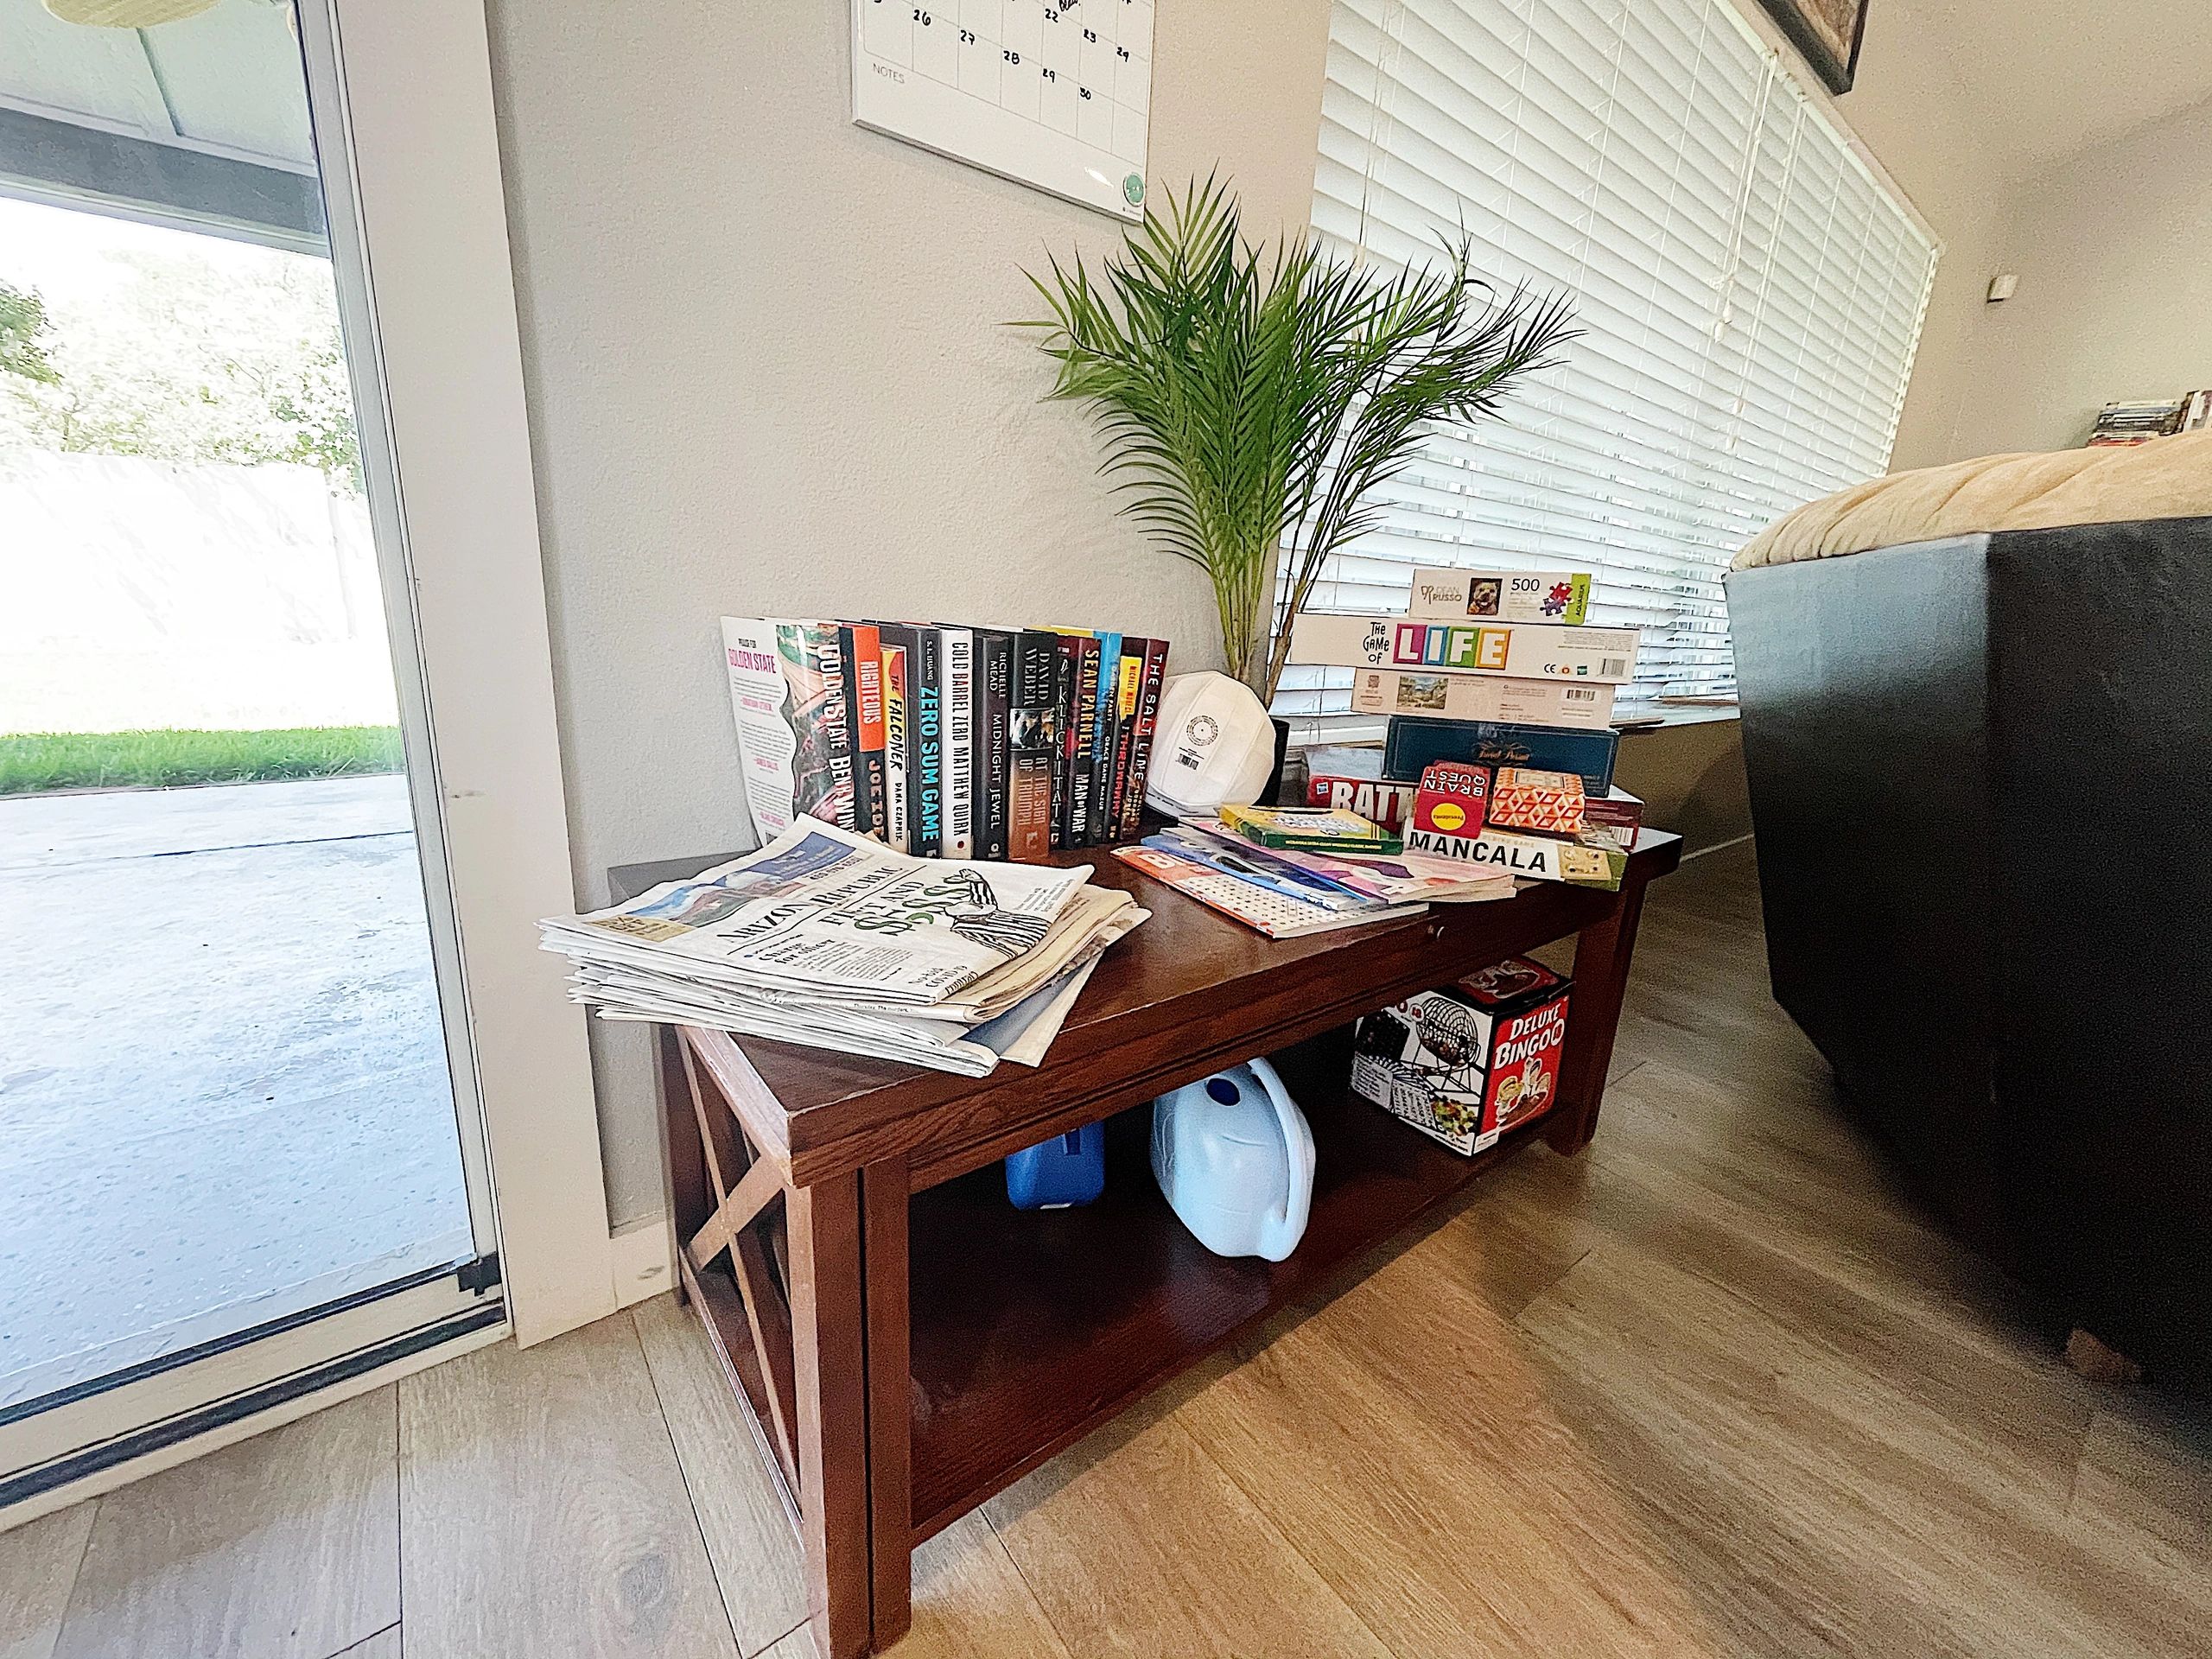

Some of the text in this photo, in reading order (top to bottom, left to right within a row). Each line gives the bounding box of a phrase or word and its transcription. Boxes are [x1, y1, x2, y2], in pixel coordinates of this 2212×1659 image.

[912, 9, 931, 26] 26
[1045, 8, 1058, 23] 22
[960, 29, 976, 46] 27
[1084, 29, 1096, 43] 23
[873, 63, 905, 84] NOTES
[1003, 50, 1020, 65] 28
[1042, 67, 1056, 84] 29
[1079, 86, 1092, 100] 30
[1432, 594, 1462, 602] RUSSO
[1436, 584, 1460, 594] DEAN
[1510, 578, 1541, 592] 500
[753, 652, 777, 674] STATE
[1395, 626, 1509, 669] LIFE
[817, 643, 844, 704] GOLDEN
[989, 660, 998, 691] MEAD
[998, 652, 1007, 699] RICHELLE
[1023, 647, 1037, 707] WEBER
[1038, 652, 1051, 701] DAVID
[1083, 649, 1100, 689] SEAN
[823, 704, 849, 750] STATE
[920, 686, 939, 737] ZERO
[1077, 694, 1096, 760] PARNELL
[1106, 698, 1115, 722] PARTY
[1134, 653, 1163, 781] THE SALT LINE
[859, 660, 885, 836] RIGHTEOUS JOE IDE
[887, 674, 904, 842] THE FALCONER DANA CZAPNIK
[951, 642, 969, 836] COLD BARREL ZERO MATTHEW QUIRK
[1052, 685, 1068, 818] KLICKITAT
[829, 754, 851, 785] BEN
[921, 741, 939, 785] SUM
[988, 714, 1002, 830] MIDNIGHT JEWEL
[1426, 769, 1486, 785] QUEST
[1017, 759, 1033, 826] OF TRIUMPH
[1033, 757, 1048, 825] AT THE SIGN
[1073, 773, 1090, 800] MAN
[1331, 781, 1418, 823] BATT
[1423, 779, 1484, 797] BRAIN
[833, 794, 855, 834] WINT
[921, 788, 939, 842] GAME
[1071, 807, 1087, 833] WAR
[1408, 831, 1548, 873] MANCALA
[716, 902, 815, 944] ARIZON
[809, 866, 903, 907] REPUBLIC
[818, 880, 925, 926] FIST AND
[774, 953, 799, 964] for
[1508, 1002, 1561, 1041] DELUXE
